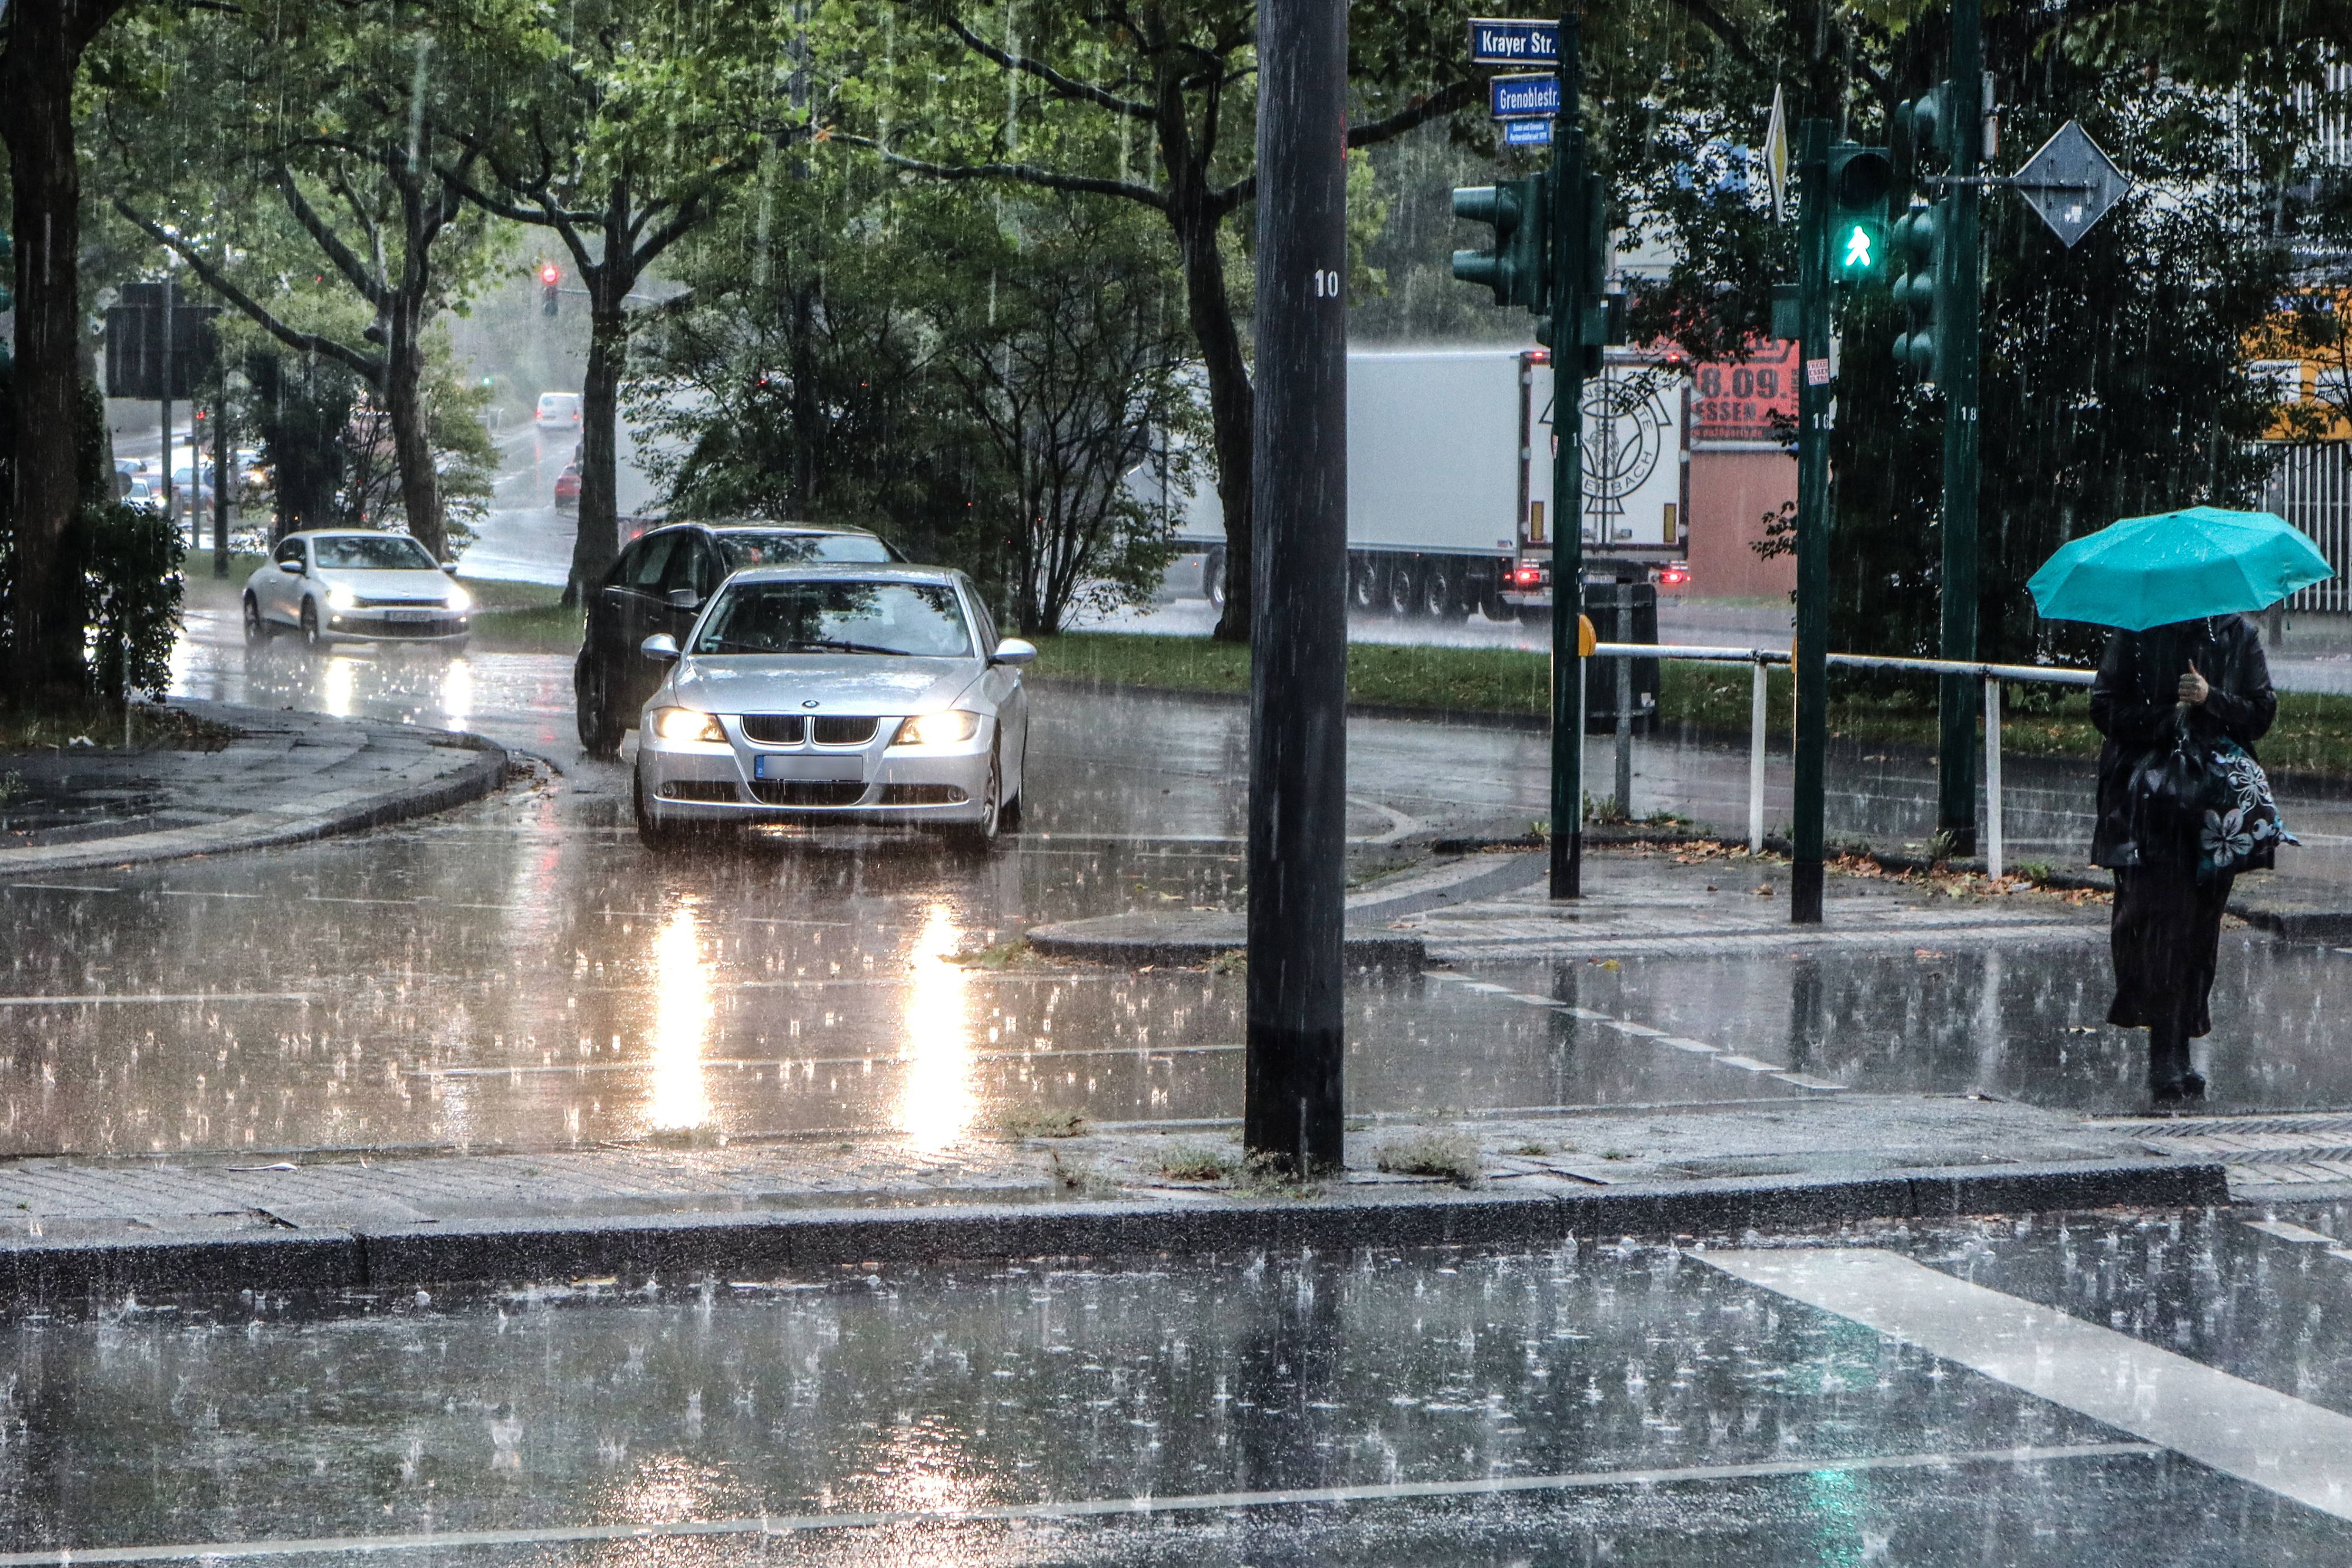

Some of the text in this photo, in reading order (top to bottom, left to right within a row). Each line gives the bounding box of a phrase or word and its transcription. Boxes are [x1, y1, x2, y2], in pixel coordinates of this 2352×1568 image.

[1482, 30, 1556, 56] Krayer Str.
[1500, 87, 1560, 109] Grenoblestr.
[1315, 269, 1338, 297] 10
[1696, 367, 1788, 399] 8.09.
[1962, 406, 1976, 421] 18
[1582, 451, 1652, 493] ERBACH
